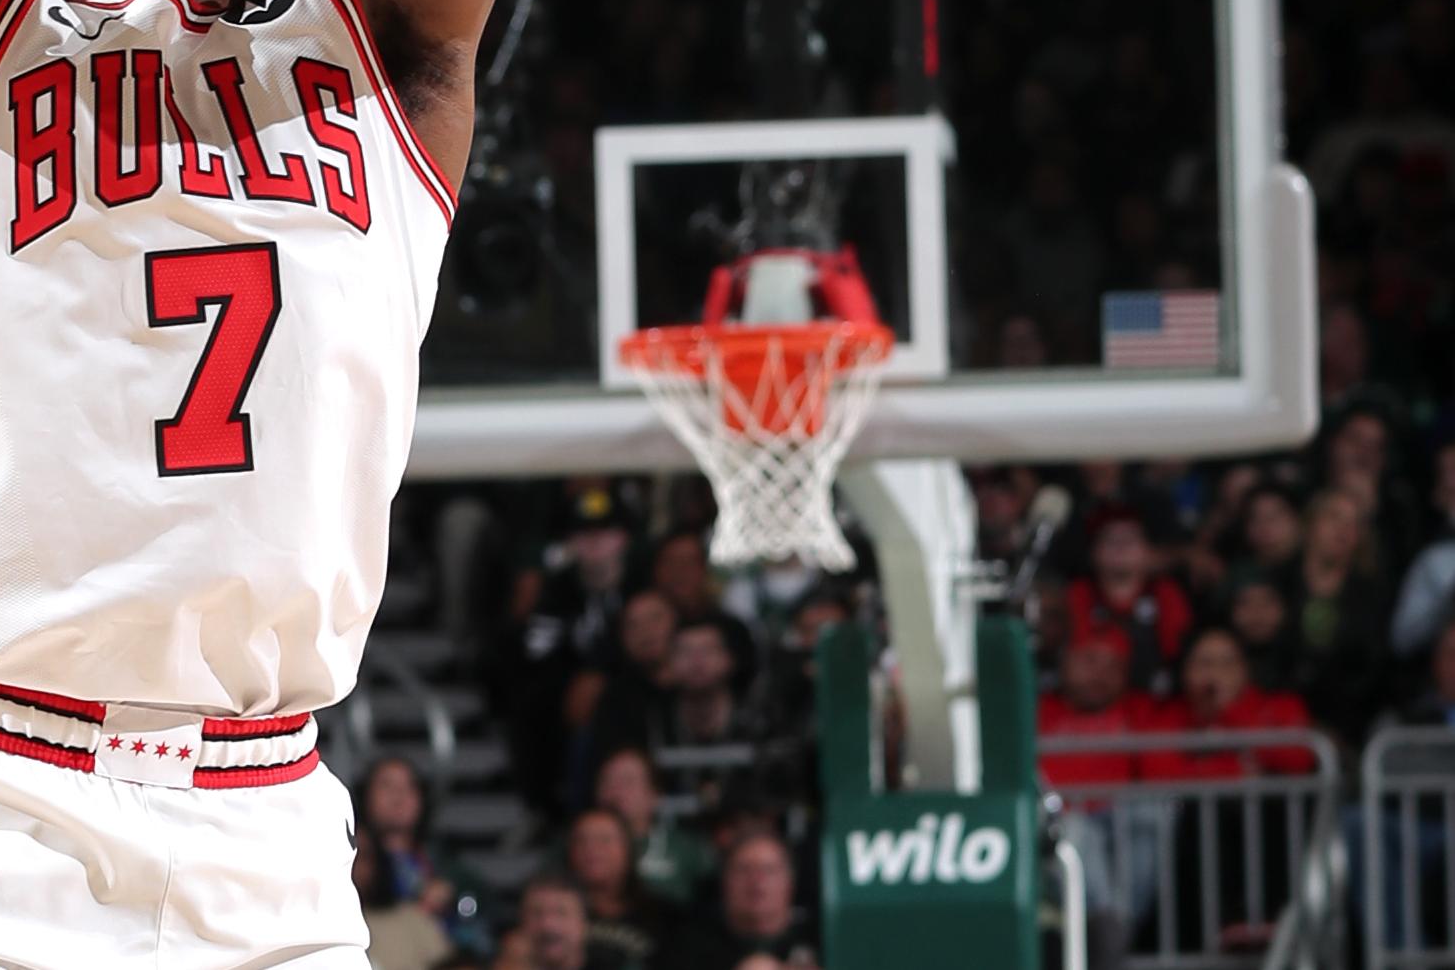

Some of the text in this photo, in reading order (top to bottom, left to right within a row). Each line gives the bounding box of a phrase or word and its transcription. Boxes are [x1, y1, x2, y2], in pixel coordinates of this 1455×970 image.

[8, 48, 372, 255] BULLS
[144, 241, 283, 477] 7
[846, 811, 1011, 885] wilo
